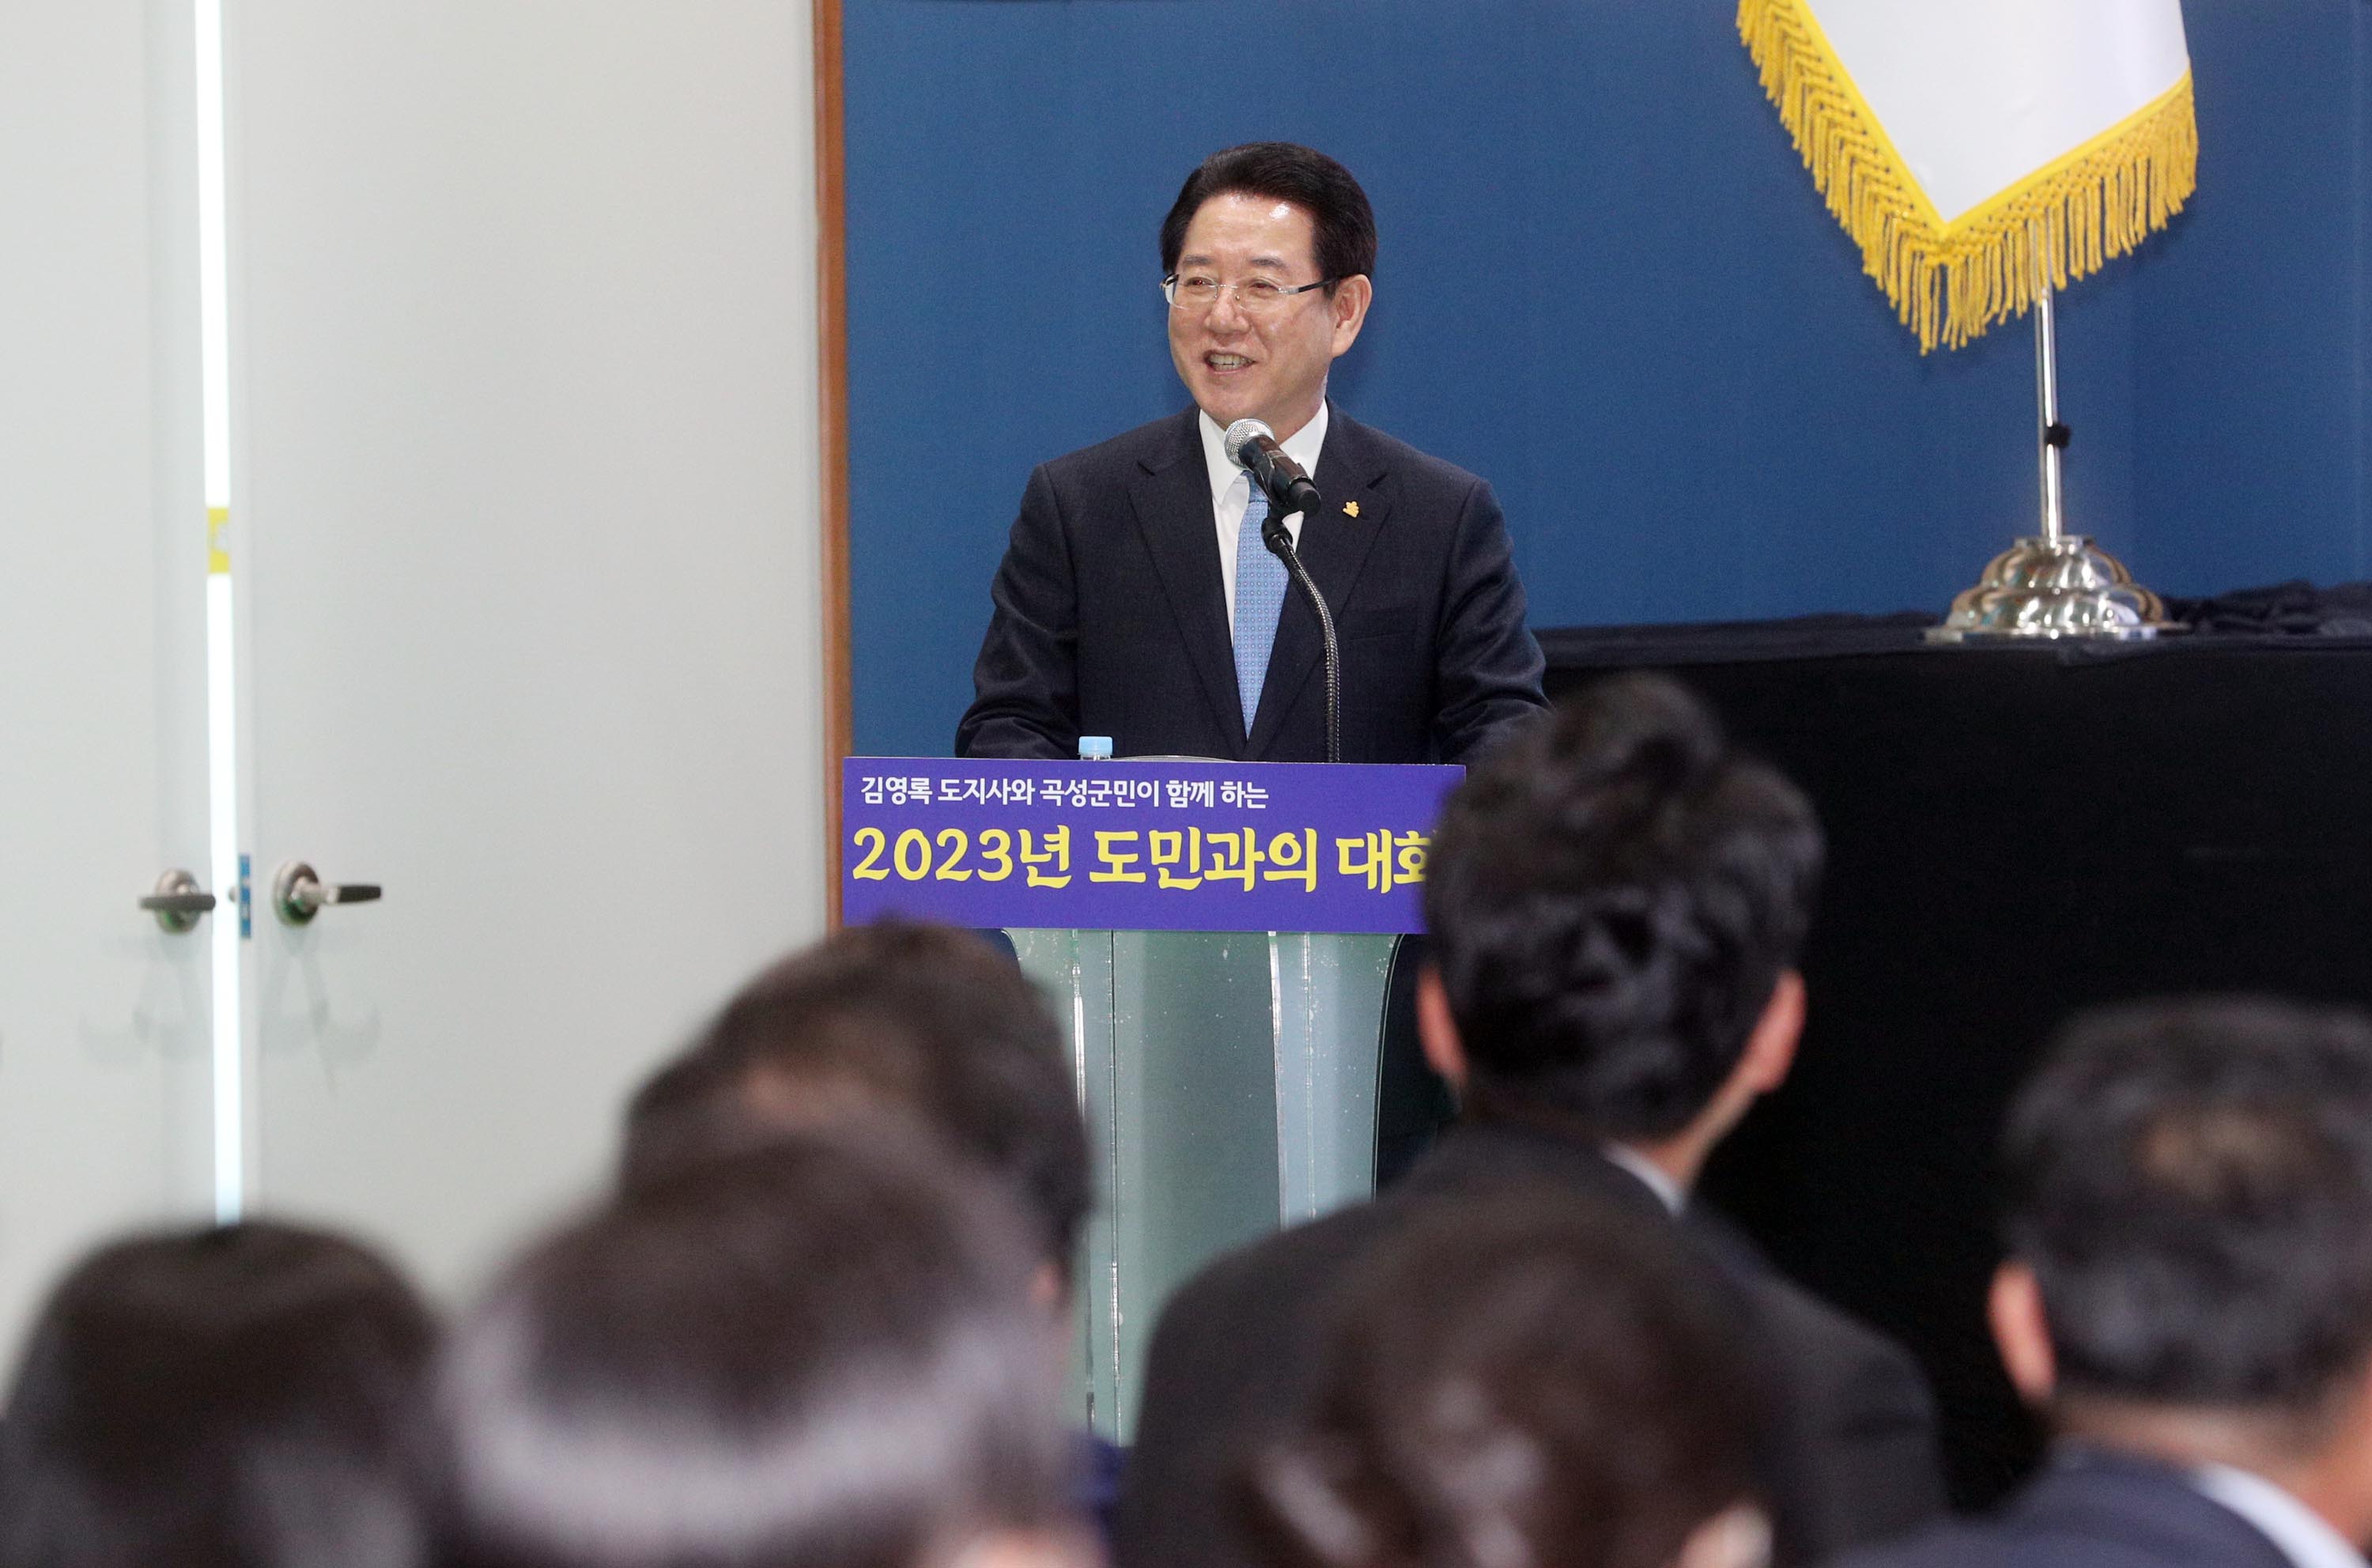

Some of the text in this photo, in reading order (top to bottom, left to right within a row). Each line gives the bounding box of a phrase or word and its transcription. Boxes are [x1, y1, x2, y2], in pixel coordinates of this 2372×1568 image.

[860, 776, 1269, 809] 김영록 도지사와 곡성군민이 함께 하는
[852, 825, 1072, 889] 2023년
[1089, 826, 1317, 893] 도민과의
